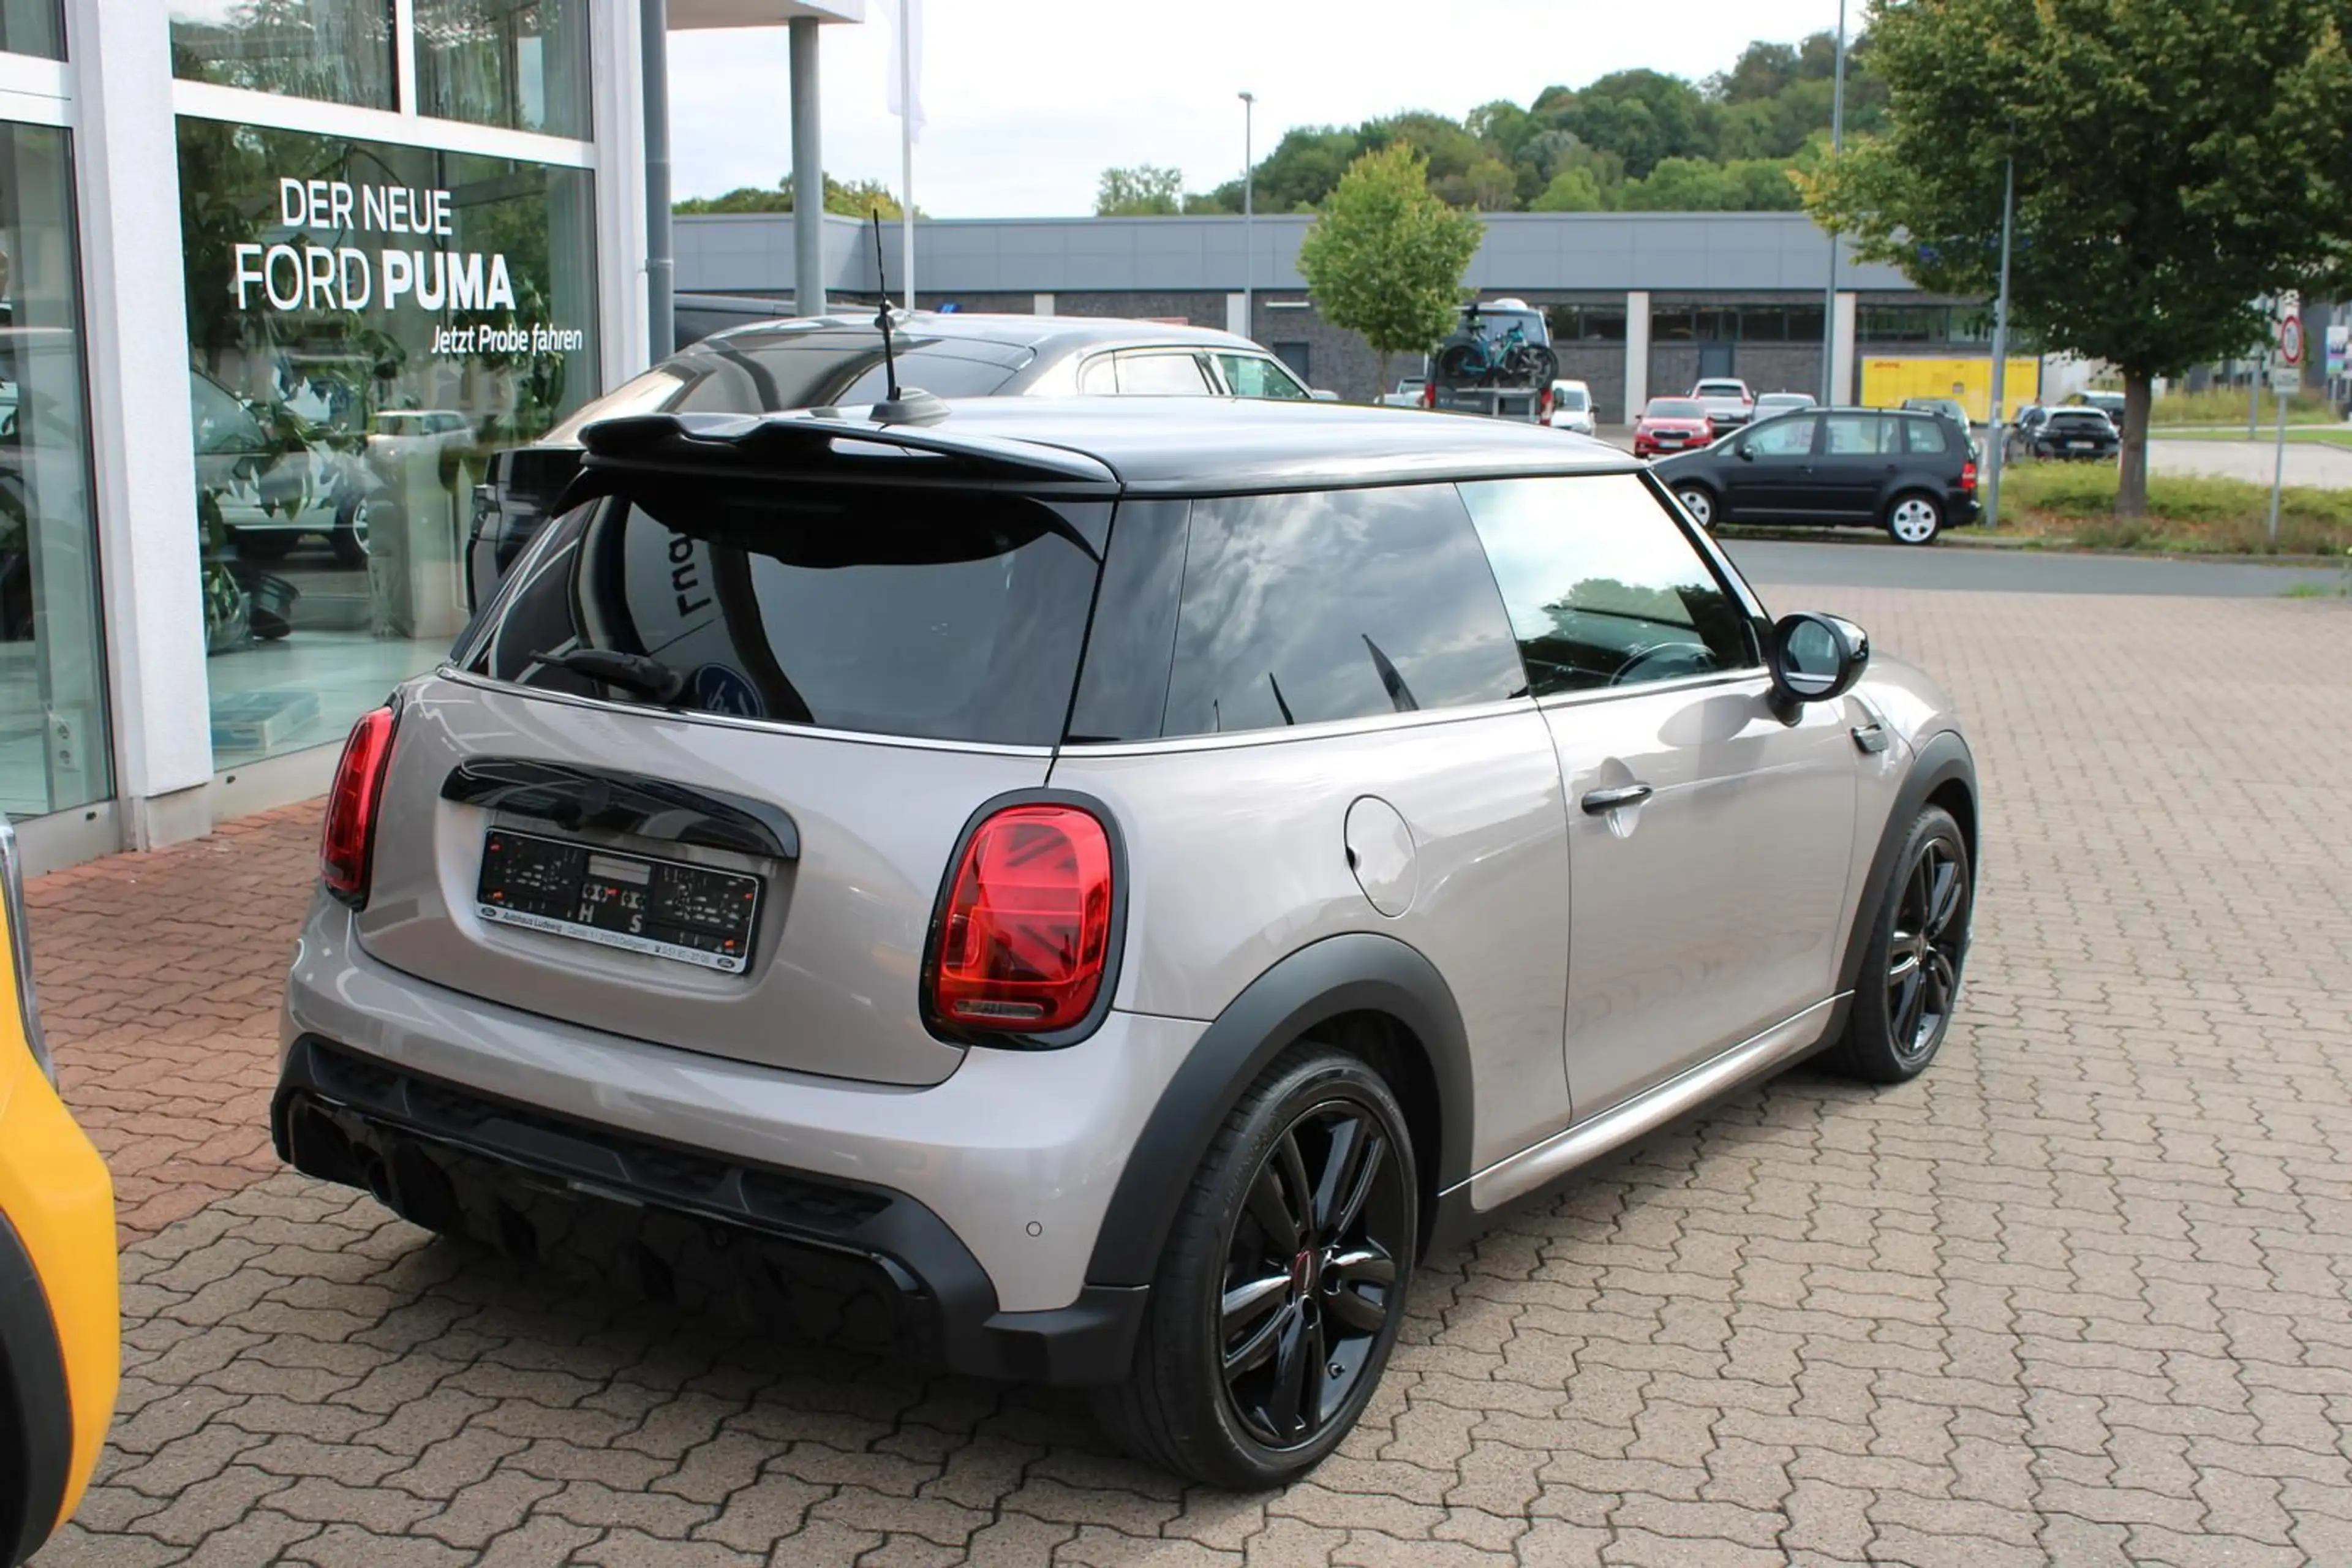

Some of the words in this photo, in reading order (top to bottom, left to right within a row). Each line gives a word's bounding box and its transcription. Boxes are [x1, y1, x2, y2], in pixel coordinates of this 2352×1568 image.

[280, 178, 354, 229] DER
[363, 184, 453, 235] NEUE
[235, 244, 371, 311] FORD
[382, 249, 516, 311] PUMA
[431, 324, 475, 353] Jetzt
[479, 323, 529, 352] Probe
[532, 322, 582, 356] fahren
